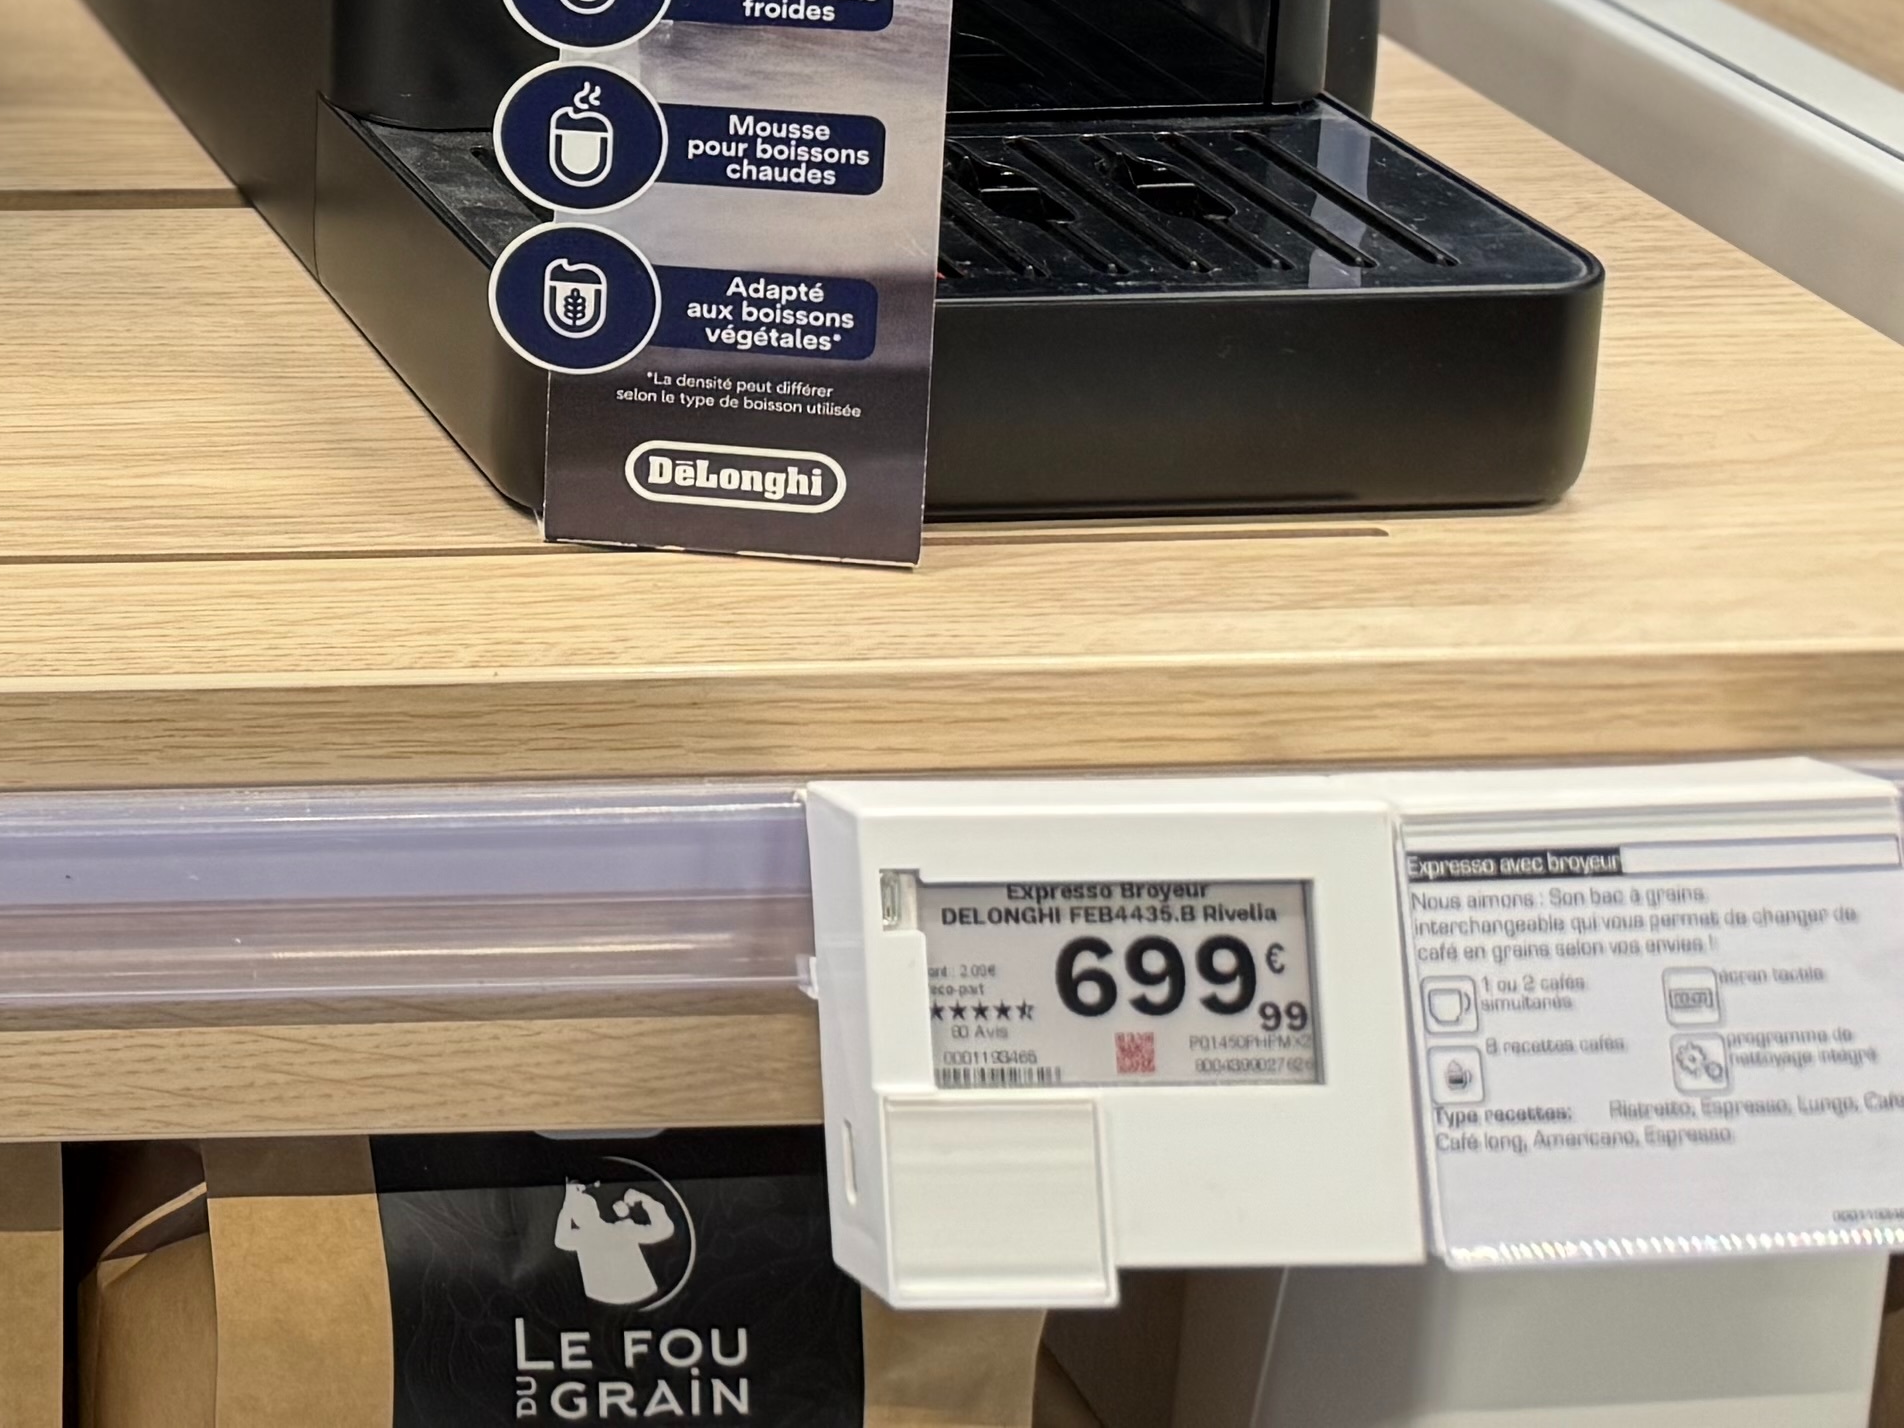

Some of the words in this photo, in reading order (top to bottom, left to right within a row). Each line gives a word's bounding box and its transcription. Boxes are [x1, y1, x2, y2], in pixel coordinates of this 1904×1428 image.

[729, 115, 830, 140] Mousse
[687, 138, 747, 161] pour
[756, 142, 869, 165] boissons
[726, 160, 836, 185] chaudes
[726, 277, 824, 303] Adapté
[687, 301, 732, 320] aux
[742, 301, 854, 329] boissons
[1007, 883, 1113, 903] Expresso
[1120, 882, 1209, 902] Broyeur
[942, 907, 1061, 925] DELONGHI
[1203, 904, 1277, 922] Rivelia
[1056, 934, 1256, 1017] 699
[1266, 943, 1285, 974] €
[1258, 1002, 1307, 1031] 99
[624, 1328, 748, 1368] FOU
[516, 1376, 537, 1419] DU
